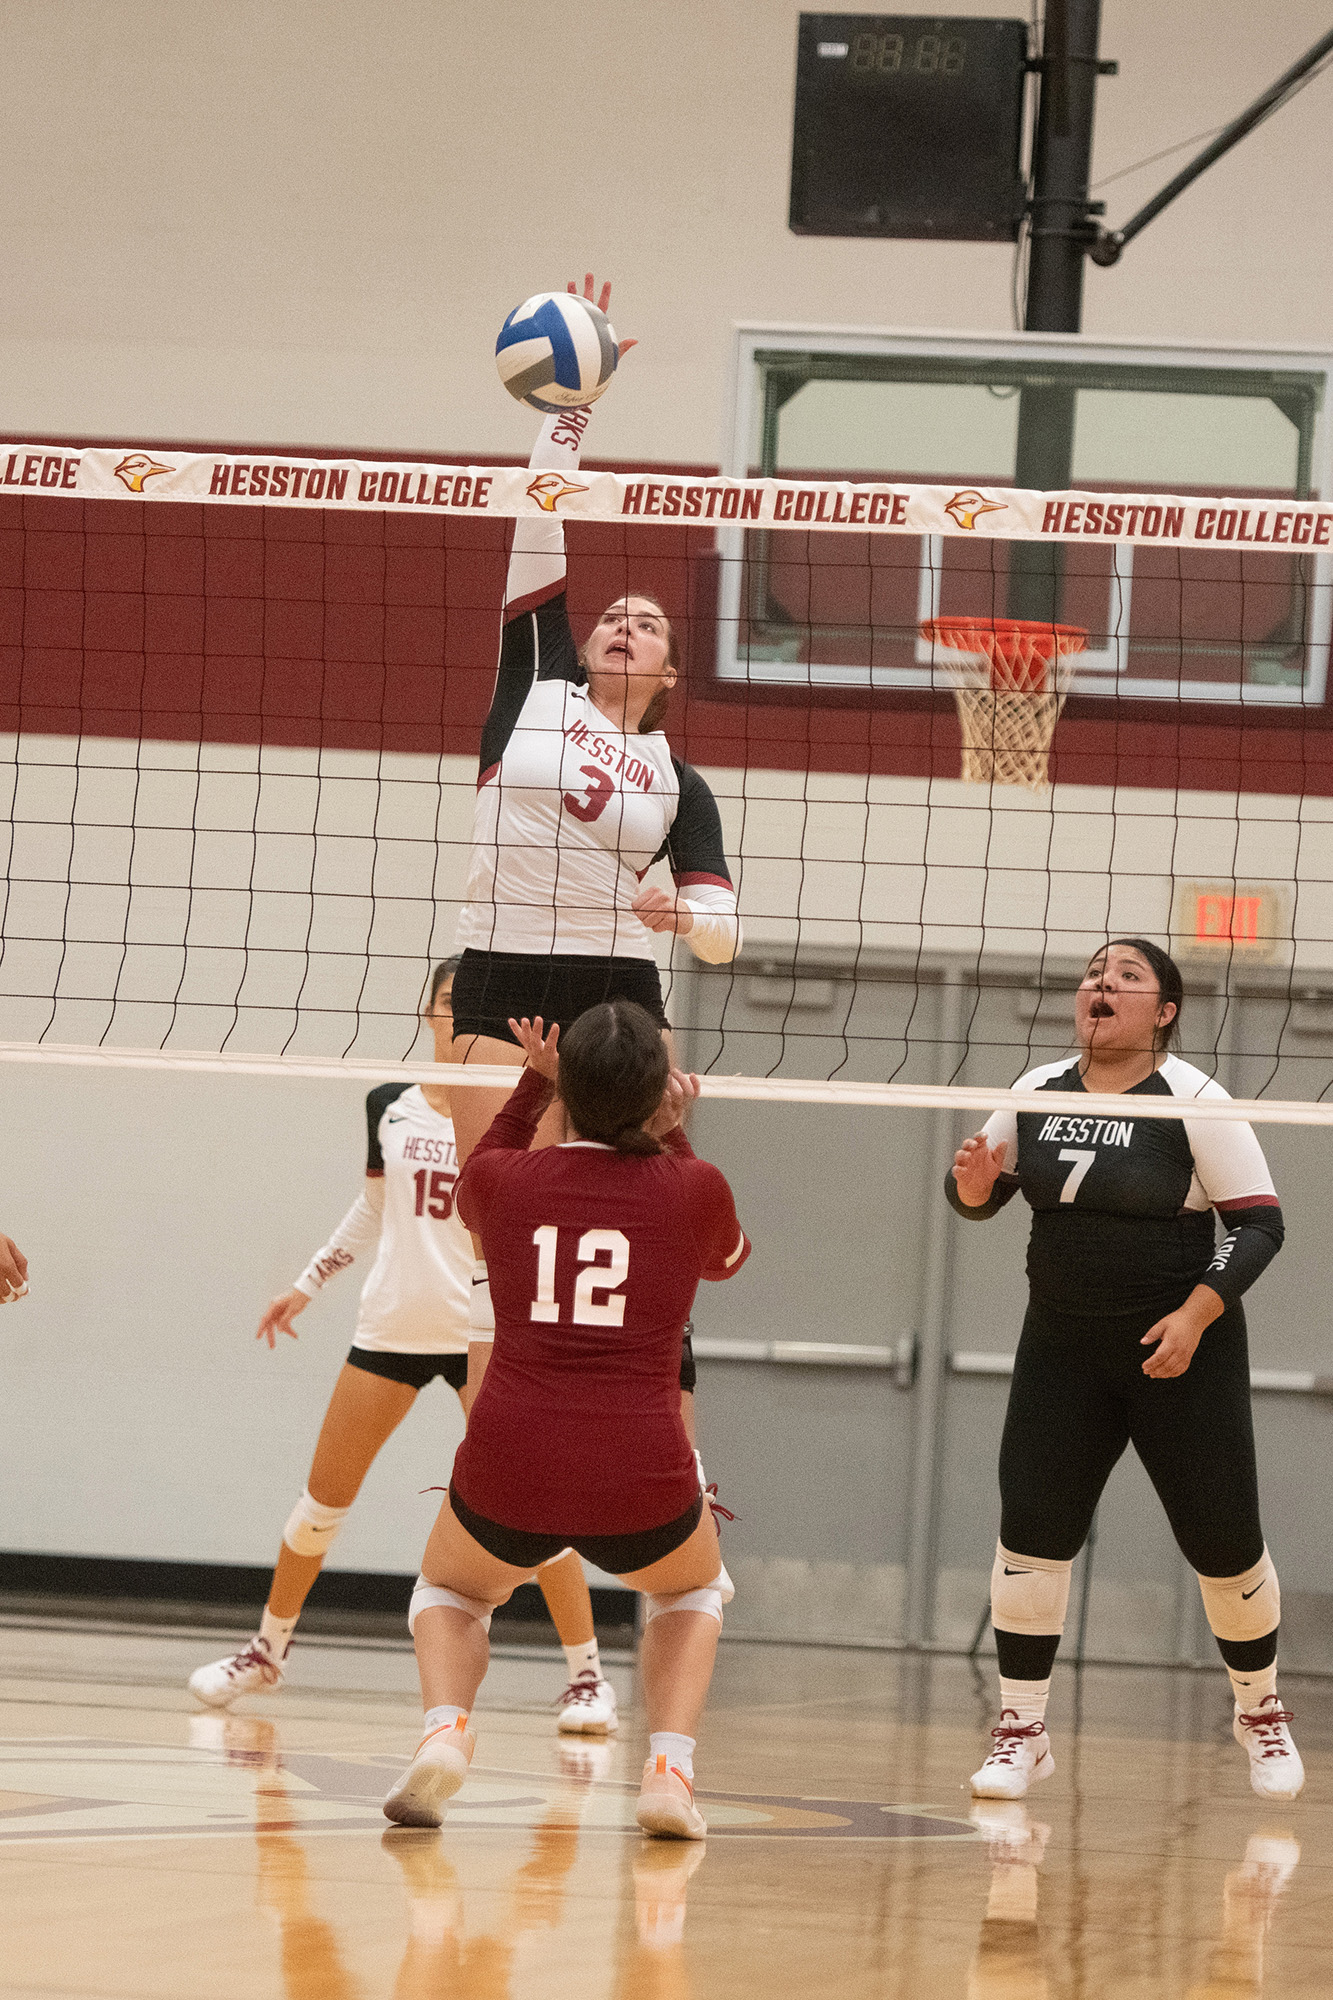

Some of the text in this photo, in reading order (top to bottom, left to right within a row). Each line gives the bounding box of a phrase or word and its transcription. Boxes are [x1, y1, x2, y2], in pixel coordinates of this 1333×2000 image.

[0, 454, 81, 489] LEGE
[208, 463, 493, 508] HESSTON COLLEGE
[621, 484, 911, 525] HESSTON COLLEGE
[1041, 501, 1333, 545] HESSTON COLLEGE
[564, 718, 655, 793] HESSTON
[563, 765, 616, 823] 3
[1195, 895, 1262, 944] EXIT
[1038, 1115, 1135, 1148] HESSTON
[413, 1168, 457, 1221] 15
[1057, 1148, 1097, 1204] 7
[307, 1247, 355, 1290] LARKS
[530, 1225, 630, 1327] 12
